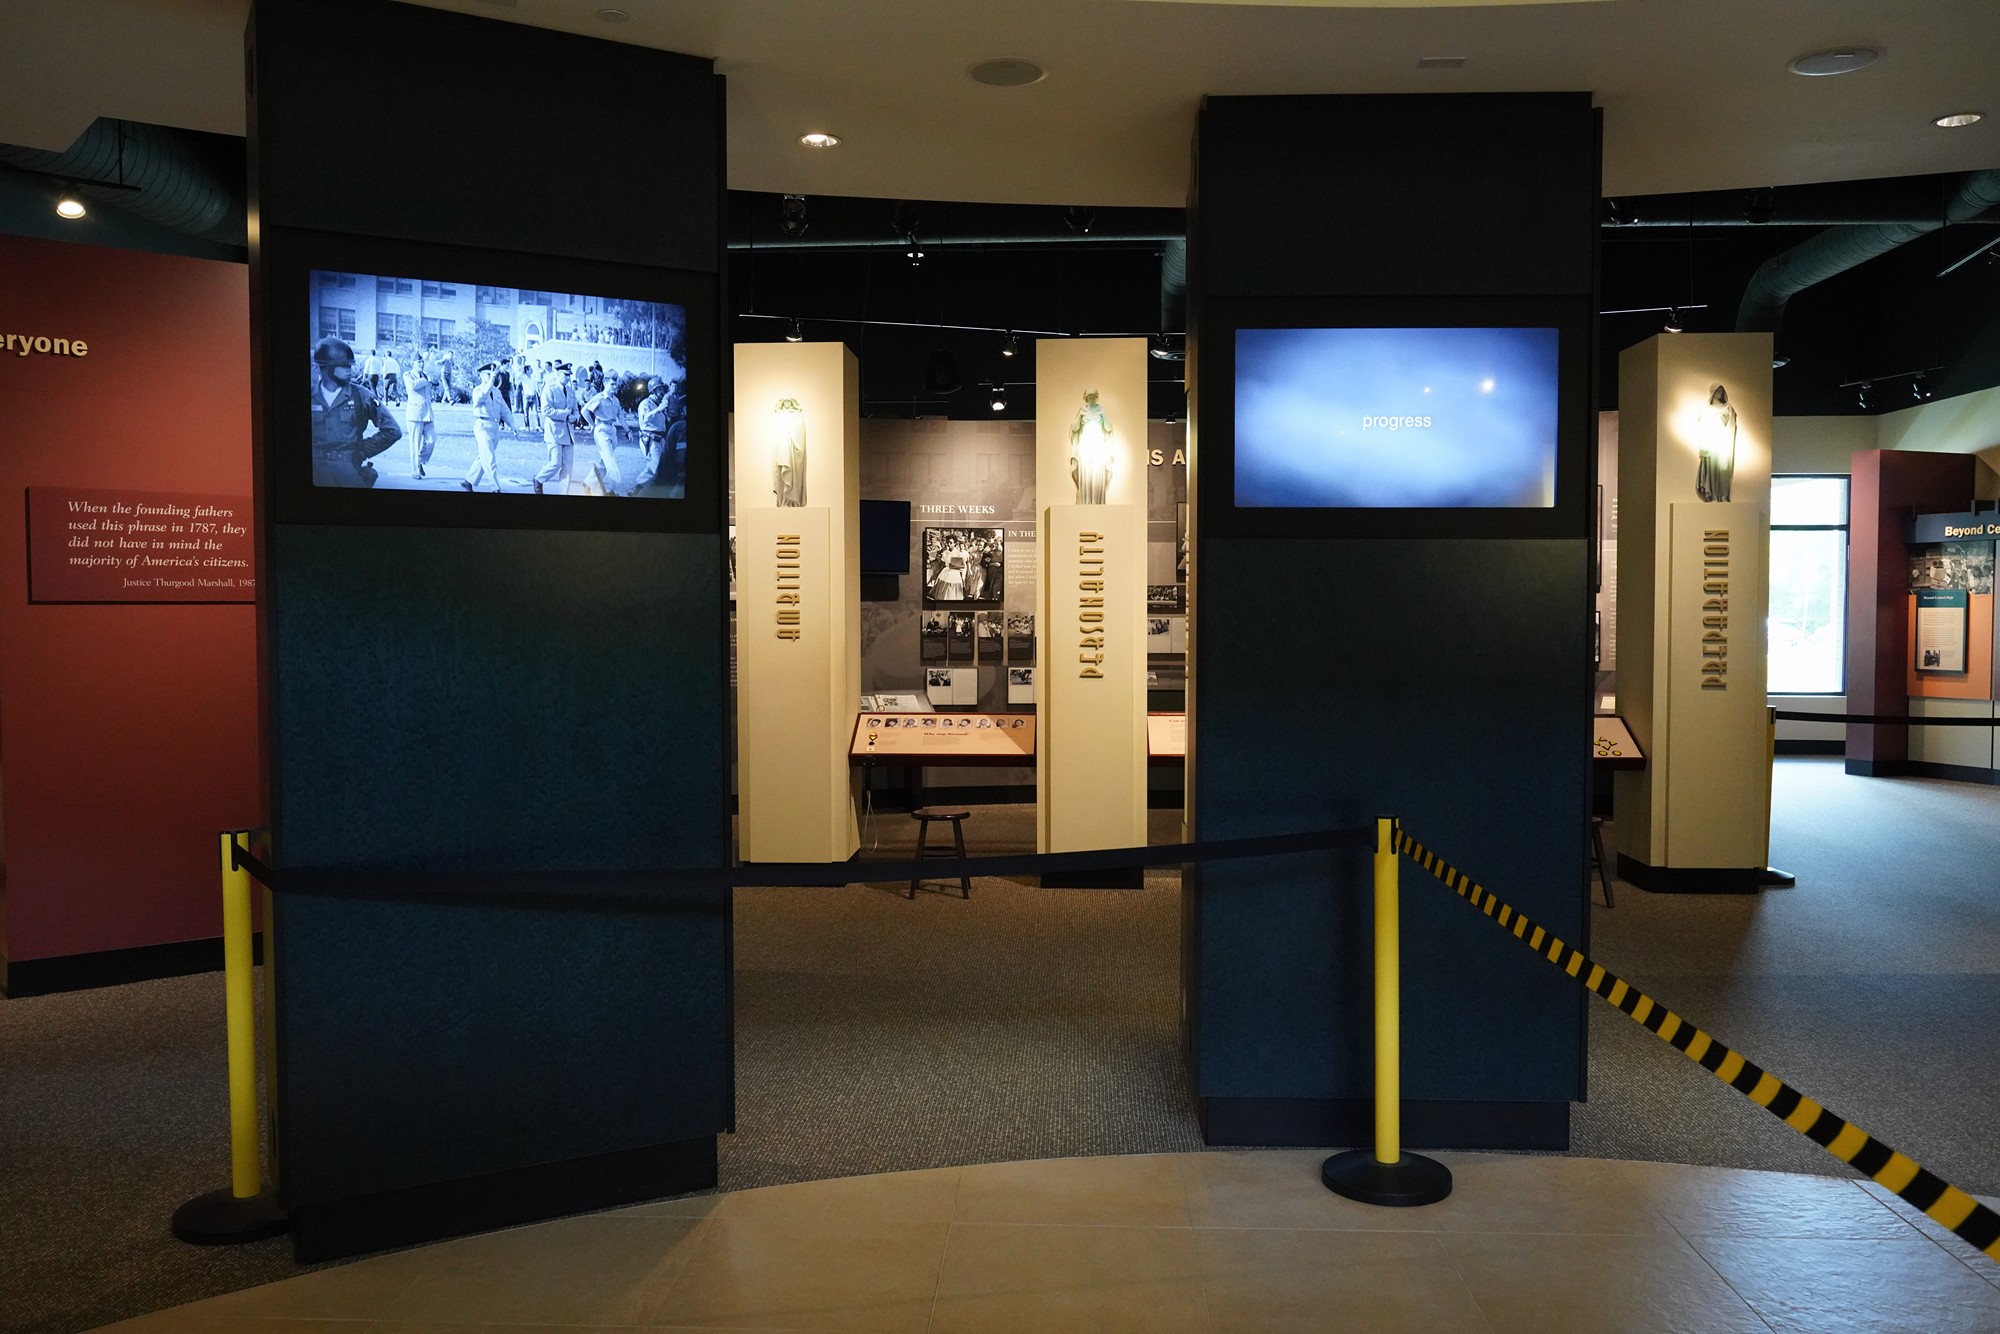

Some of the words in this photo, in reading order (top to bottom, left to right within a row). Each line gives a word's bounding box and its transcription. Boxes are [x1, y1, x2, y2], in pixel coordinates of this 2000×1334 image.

[0, 334, 88, 357] ryone
[1362, 414, 1432, 431] progress
[68, 501, 108, 513] When
[112, 502, 132, 514] the
[134, 503, 191, 518] founding
[192, 505, 234, 519] fathers
[920, 504, 956, 514] THREE
[958, 505, 995, 514] WEEKS
[68, 519, 97, 531] used
[101, 519, 124, 531] this
[128, 520, 167, 534] phrase
[171, 522, 184, 533] in
[189, 523, 218, 535] 1787,
[222, 524, 247, 537] they
[1008, 530, 1018, 538] IN
[1019, 530, 1036, 538] THE
[1945, 524, 1984, 538] Beyond
[68, 536, 89, 548] did
[94, 538, 115, 548] not
[119, 537, 148, 549] have
[152, 538, 164, 549] in
[169, 539, 200, 550] mind
[204, 539, 223, 550] the
[69, 555, 123, 568] majority
[125, 554, 139, 569] of
[141, 555, 200, 567] America's
[203, 556, 249, 567] citizens.
[123, 577, 151, 589] Justice
[154, 578, 195, 588] Thurgood
[197, 579, 236, 588] Marshall,
[776, 534, 800, 642] AMBITION
[1079, 531, 1104, 678] PERSONALITY
[1701, 530, 1730, 690] PREPARATION
